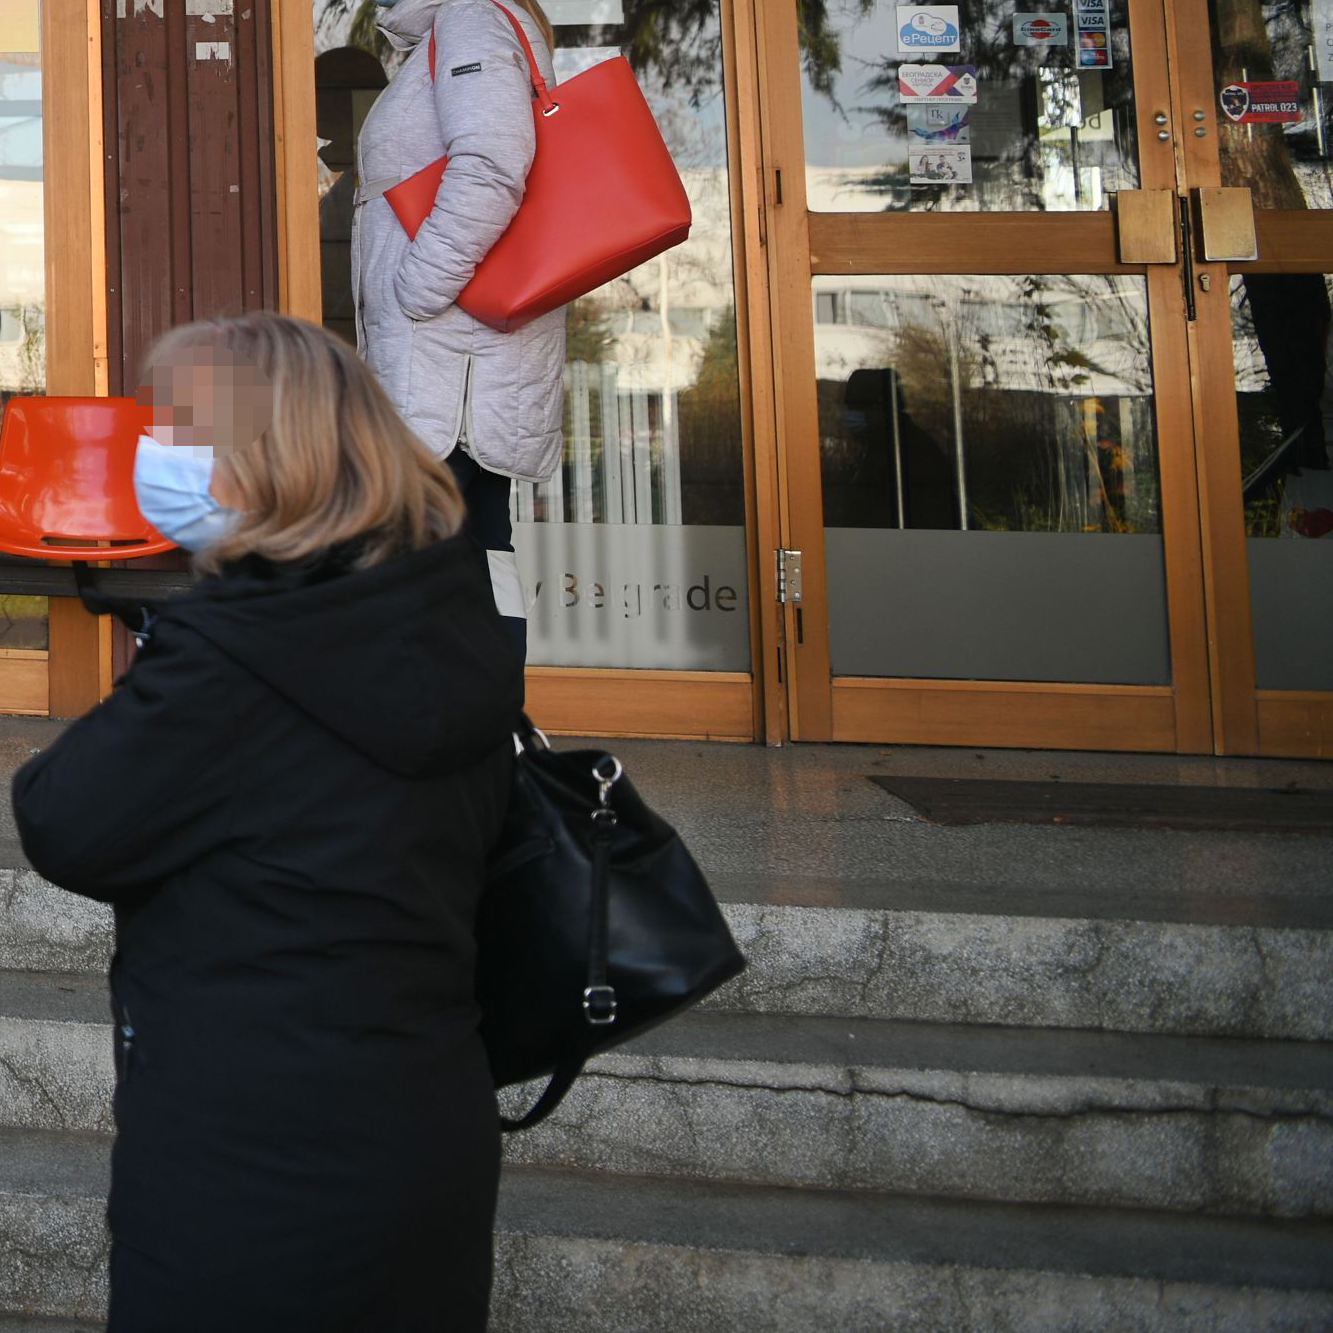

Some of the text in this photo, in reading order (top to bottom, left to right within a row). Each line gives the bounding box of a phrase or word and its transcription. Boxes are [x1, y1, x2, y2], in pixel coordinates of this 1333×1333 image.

[1080, 0, 1103, 8] VISA
[1081, 17, 1105, 25] VISA
[1252, 103, 1298, 112] PATROL 023
